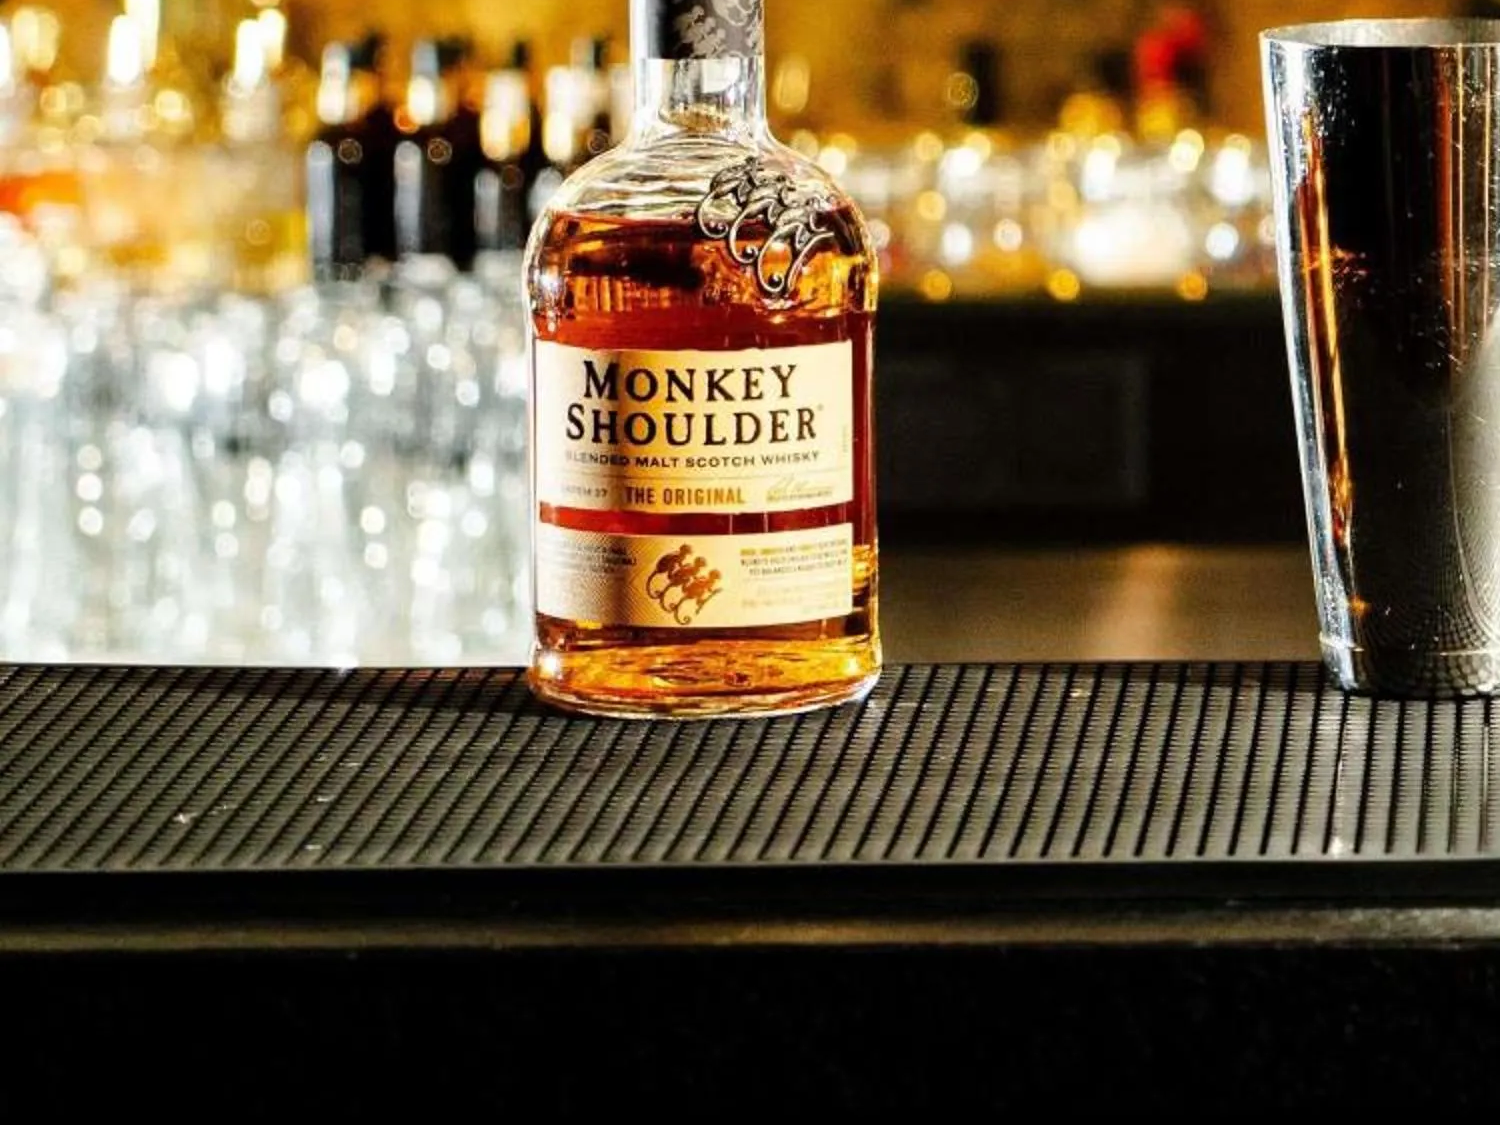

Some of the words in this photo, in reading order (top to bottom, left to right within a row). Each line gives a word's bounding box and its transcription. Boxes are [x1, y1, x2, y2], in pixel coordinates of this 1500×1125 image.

[583, 360, 797, 403] MONKEY
[565, 402, 817, 446] SHOULDER
[565, 450, 630, 466] BLENDED
[635, 456, 679, 468] MALT
[685, 455, 756, 468] SCOTCH
[761, 450, 820, 466] WHISKY
[625, 486, 656, 505] THE
[663, 486, 746, 506] ORIGINAL
